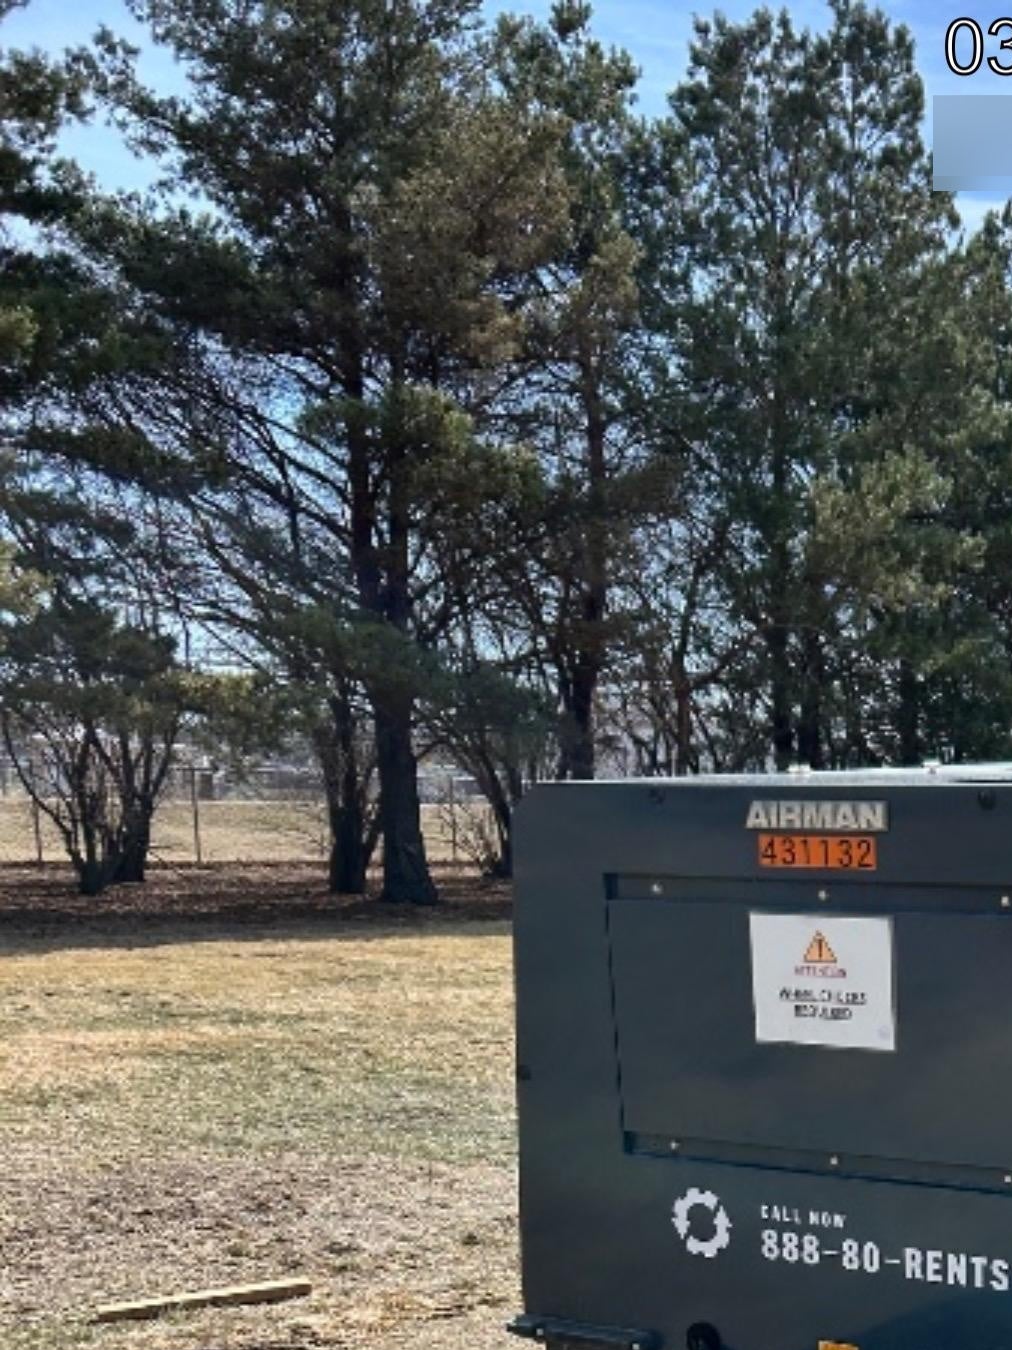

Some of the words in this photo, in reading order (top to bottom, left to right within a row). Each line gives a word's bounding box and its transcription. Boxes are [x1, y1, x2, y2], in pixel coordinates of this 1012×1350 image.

[745, 800, 886, 830] AIRMAN
[761, 835, 873, 868] 431132
[760, 1204, 802, 1225] CALL
[809, 1208, 848, 1228] NOW
[761, 1228, 1009, 1292] 888-80-RENTS
